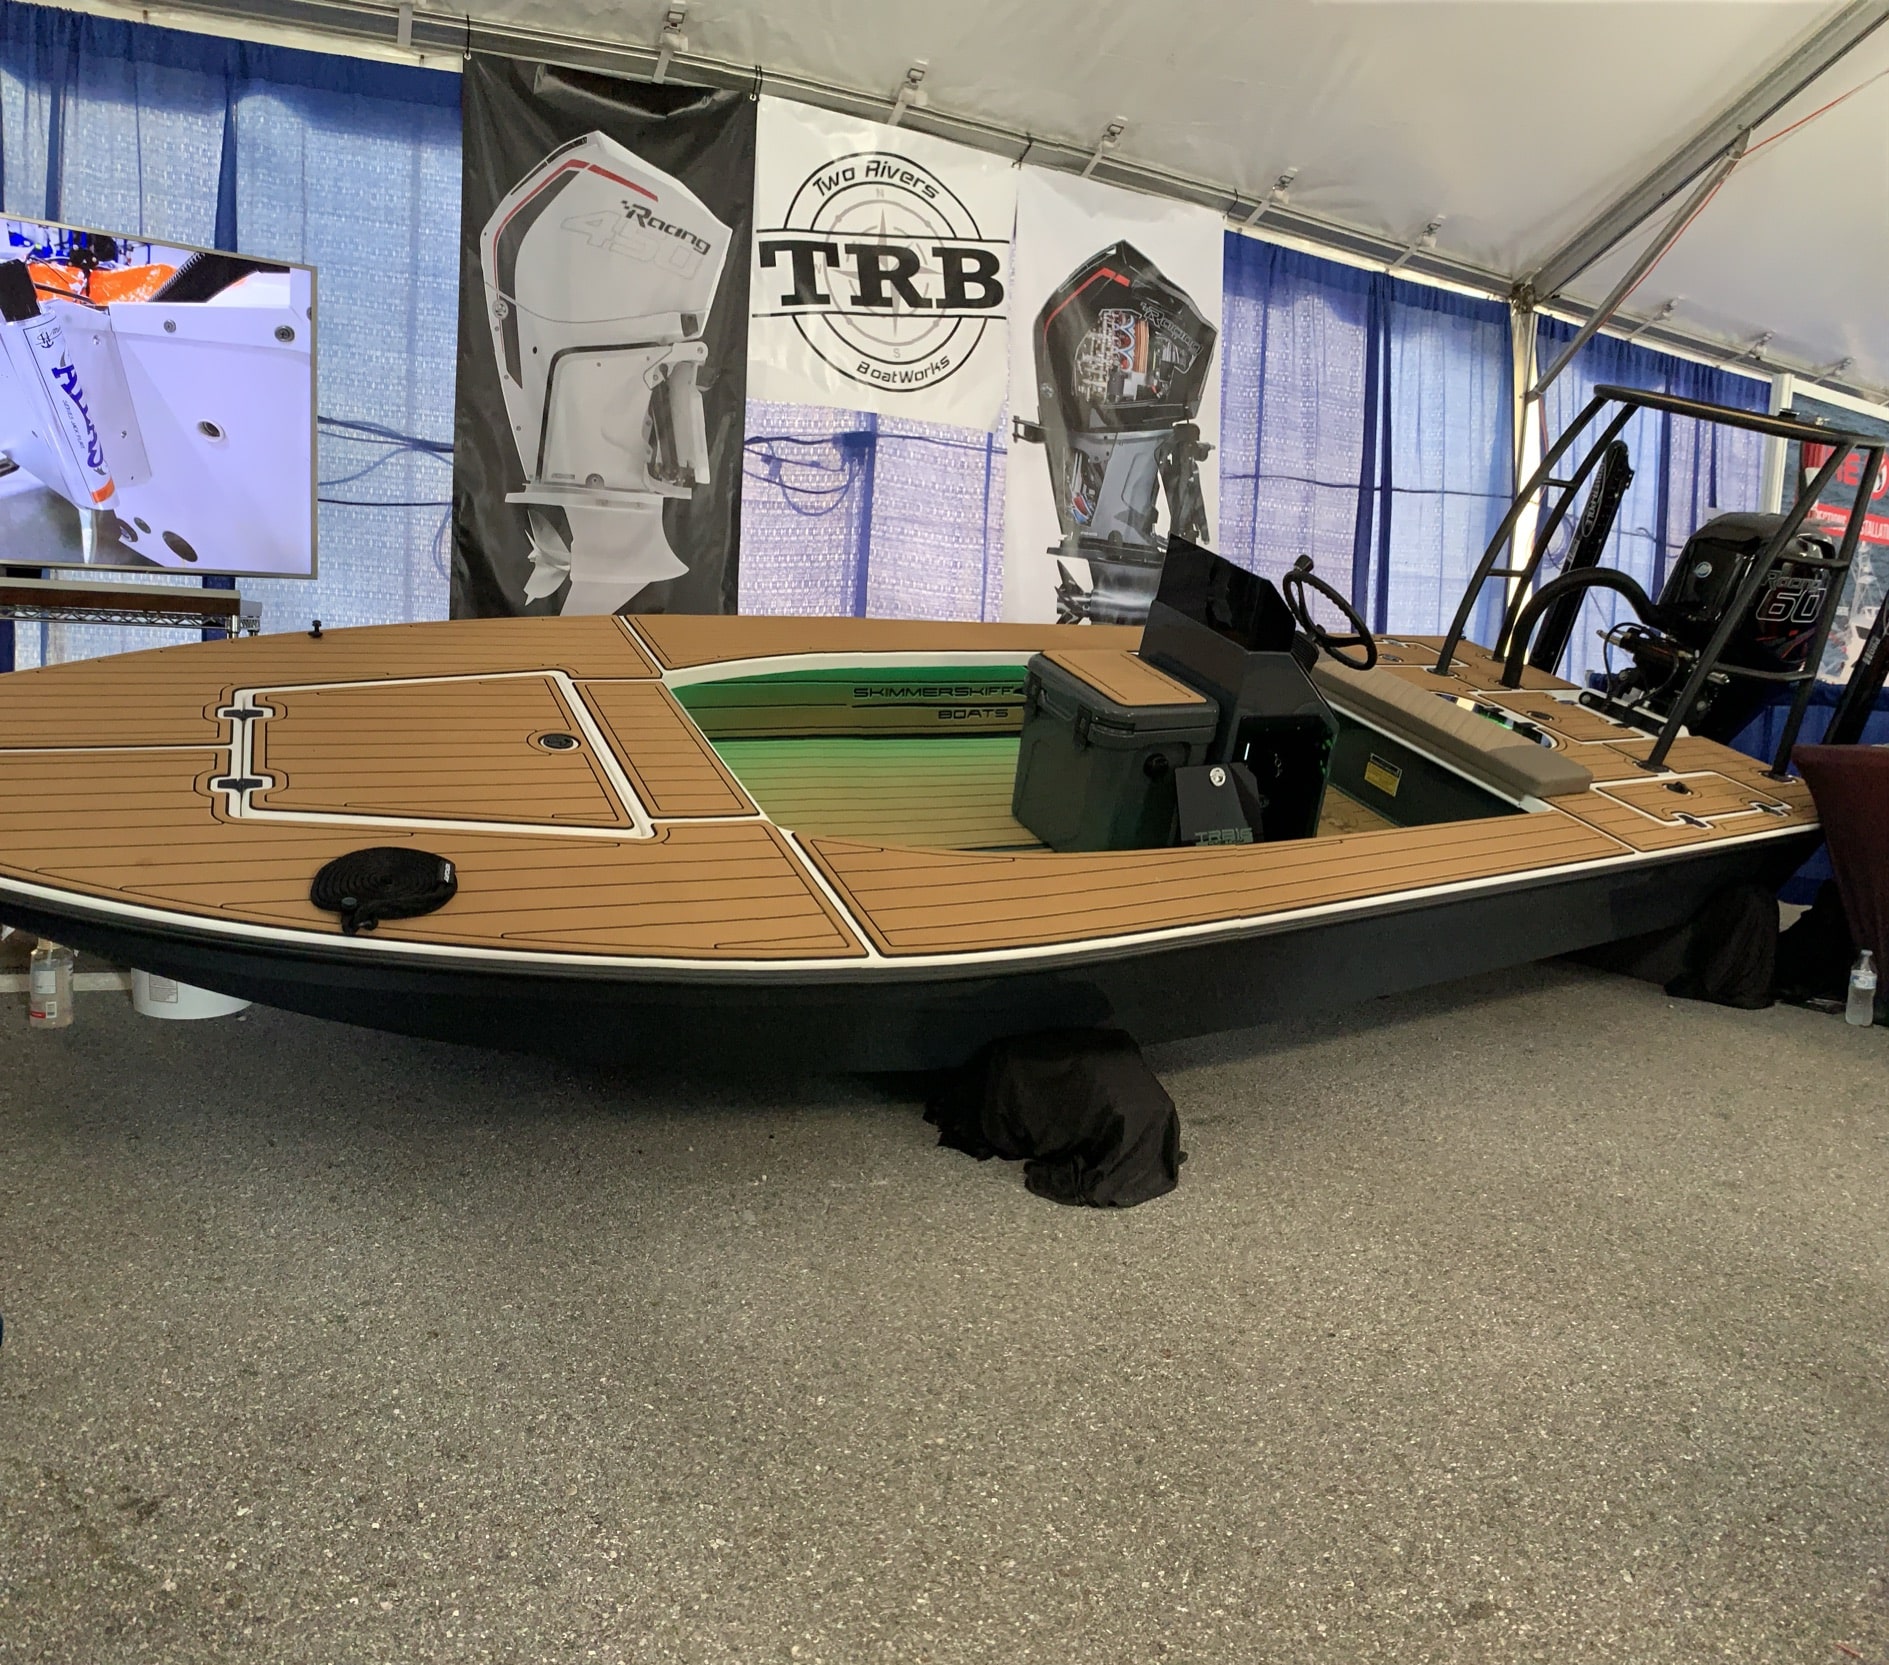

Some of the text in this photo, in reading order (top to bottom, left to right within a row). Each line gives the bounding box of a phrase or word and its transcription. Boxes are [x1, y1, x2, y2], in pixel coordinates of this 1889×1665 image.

[812, 160, 940, 199] Two Rivers
[622, 201, 711, 256] Racing
[758, 239, 1005, 309] TRB
[856, 356, 950, 383] BoatWorks
[1756, 587, 1827, 623] 60
[853, 686, 1015, 698] SKIMMERSKIFF
[938, 708, 1009, 720] BOATS
